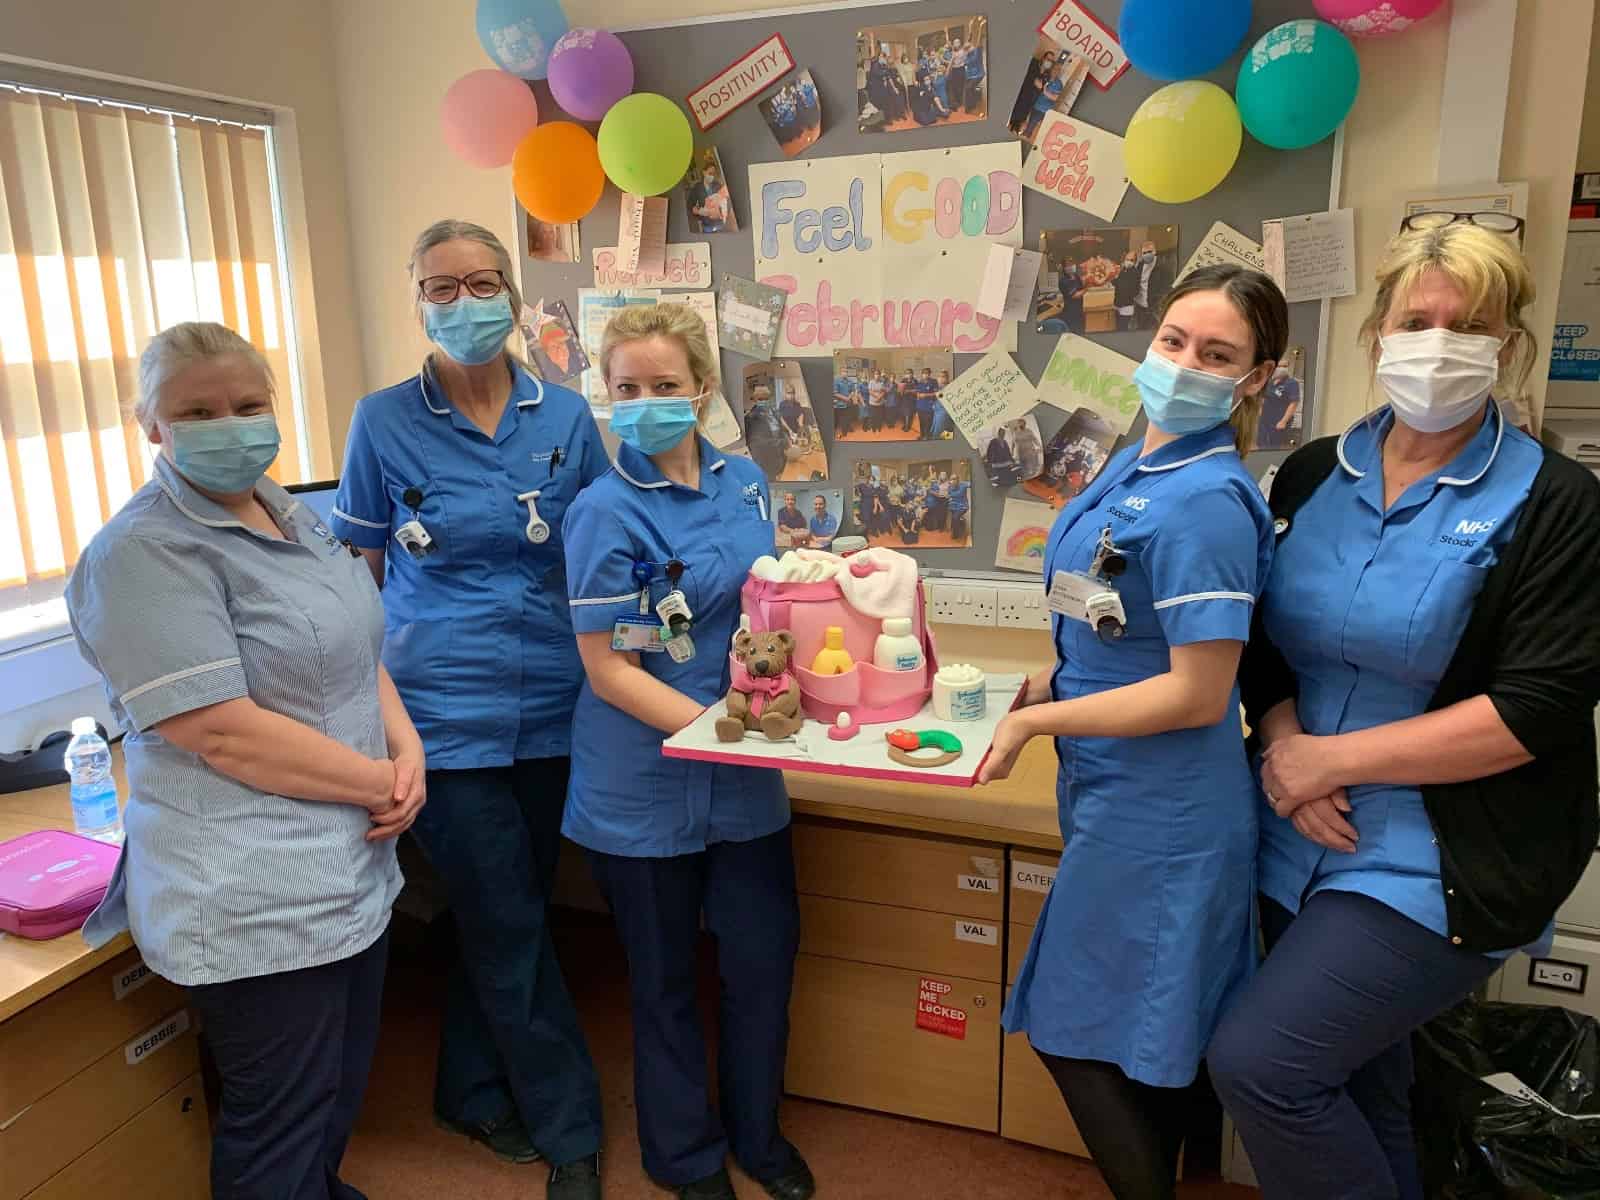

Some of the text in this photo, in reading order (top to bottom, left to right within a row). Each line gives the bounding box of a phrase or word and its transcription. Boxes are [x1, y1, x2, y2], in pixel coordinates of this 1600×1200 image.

[1055, 13, 1114, 69] BOARD
[698, 49, 778, 116] POSITIVITY
[1041, 121, 1090, 174] Eat
[761, 170, 1022, 260] Feel GOOD
[1555, 326, 1586, 337] KEEP
[1554, 338, 1572, 348] ME
[1551, 350, 1600, 361] CLOSED
[1045, 351, 1139, 415] DANCE
[1122, 496, 1151, 511] NHS
[1455, 518, 1498, 534] NHS
[968, 878, 992, 890] VAL
[963, 925, 987, 937] VAL
[920, 979, 952, 993] KEEP
[920, 990, 937, 1002] ME
[919, 1001, 966, 1021] LOCKED
[134, 1023, 177, 1058] DEBBIE
